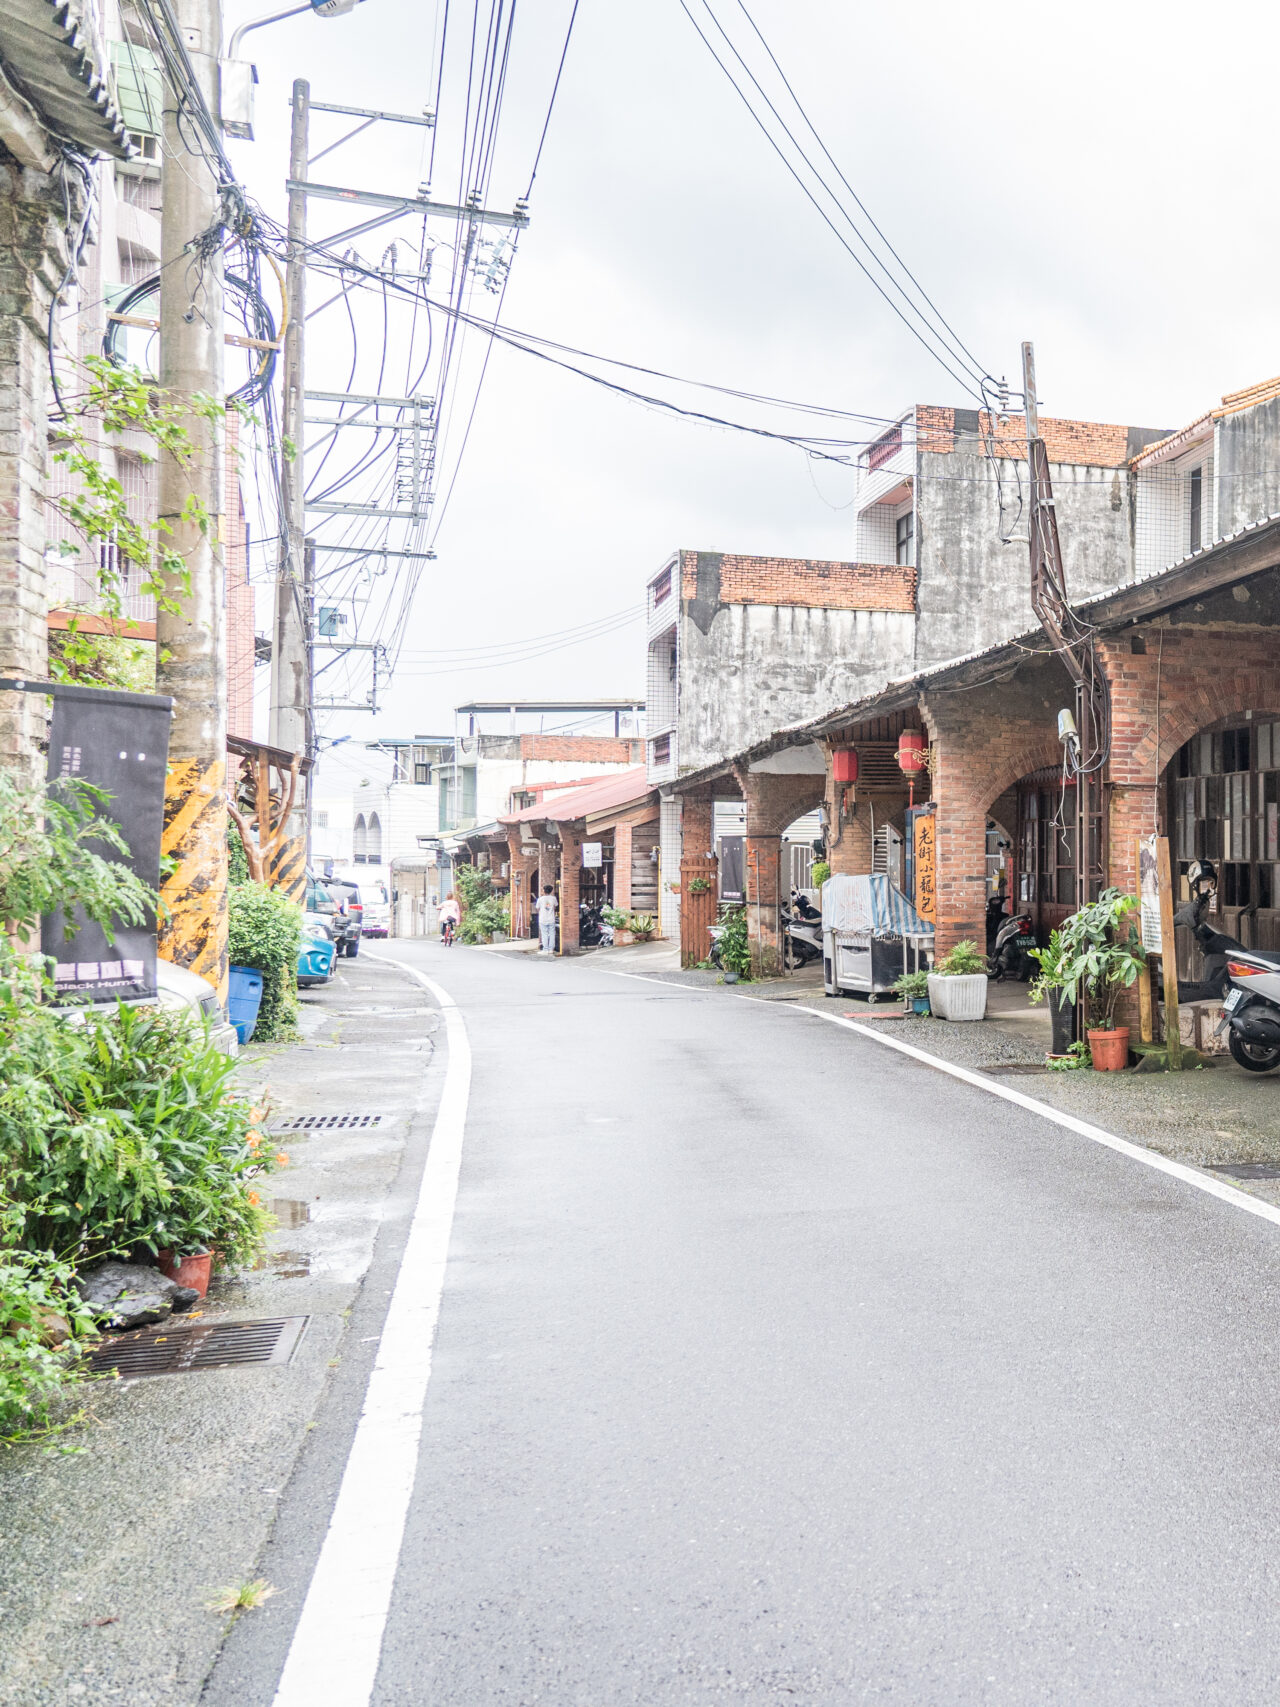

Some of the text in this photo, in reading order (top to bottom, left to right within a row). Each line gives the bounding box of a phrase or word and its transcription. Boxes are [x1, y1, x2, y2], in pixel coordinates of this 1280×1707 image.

[919, 827, 934, 913] 老街小籠包
[98, 979, 145, 988] Humor
